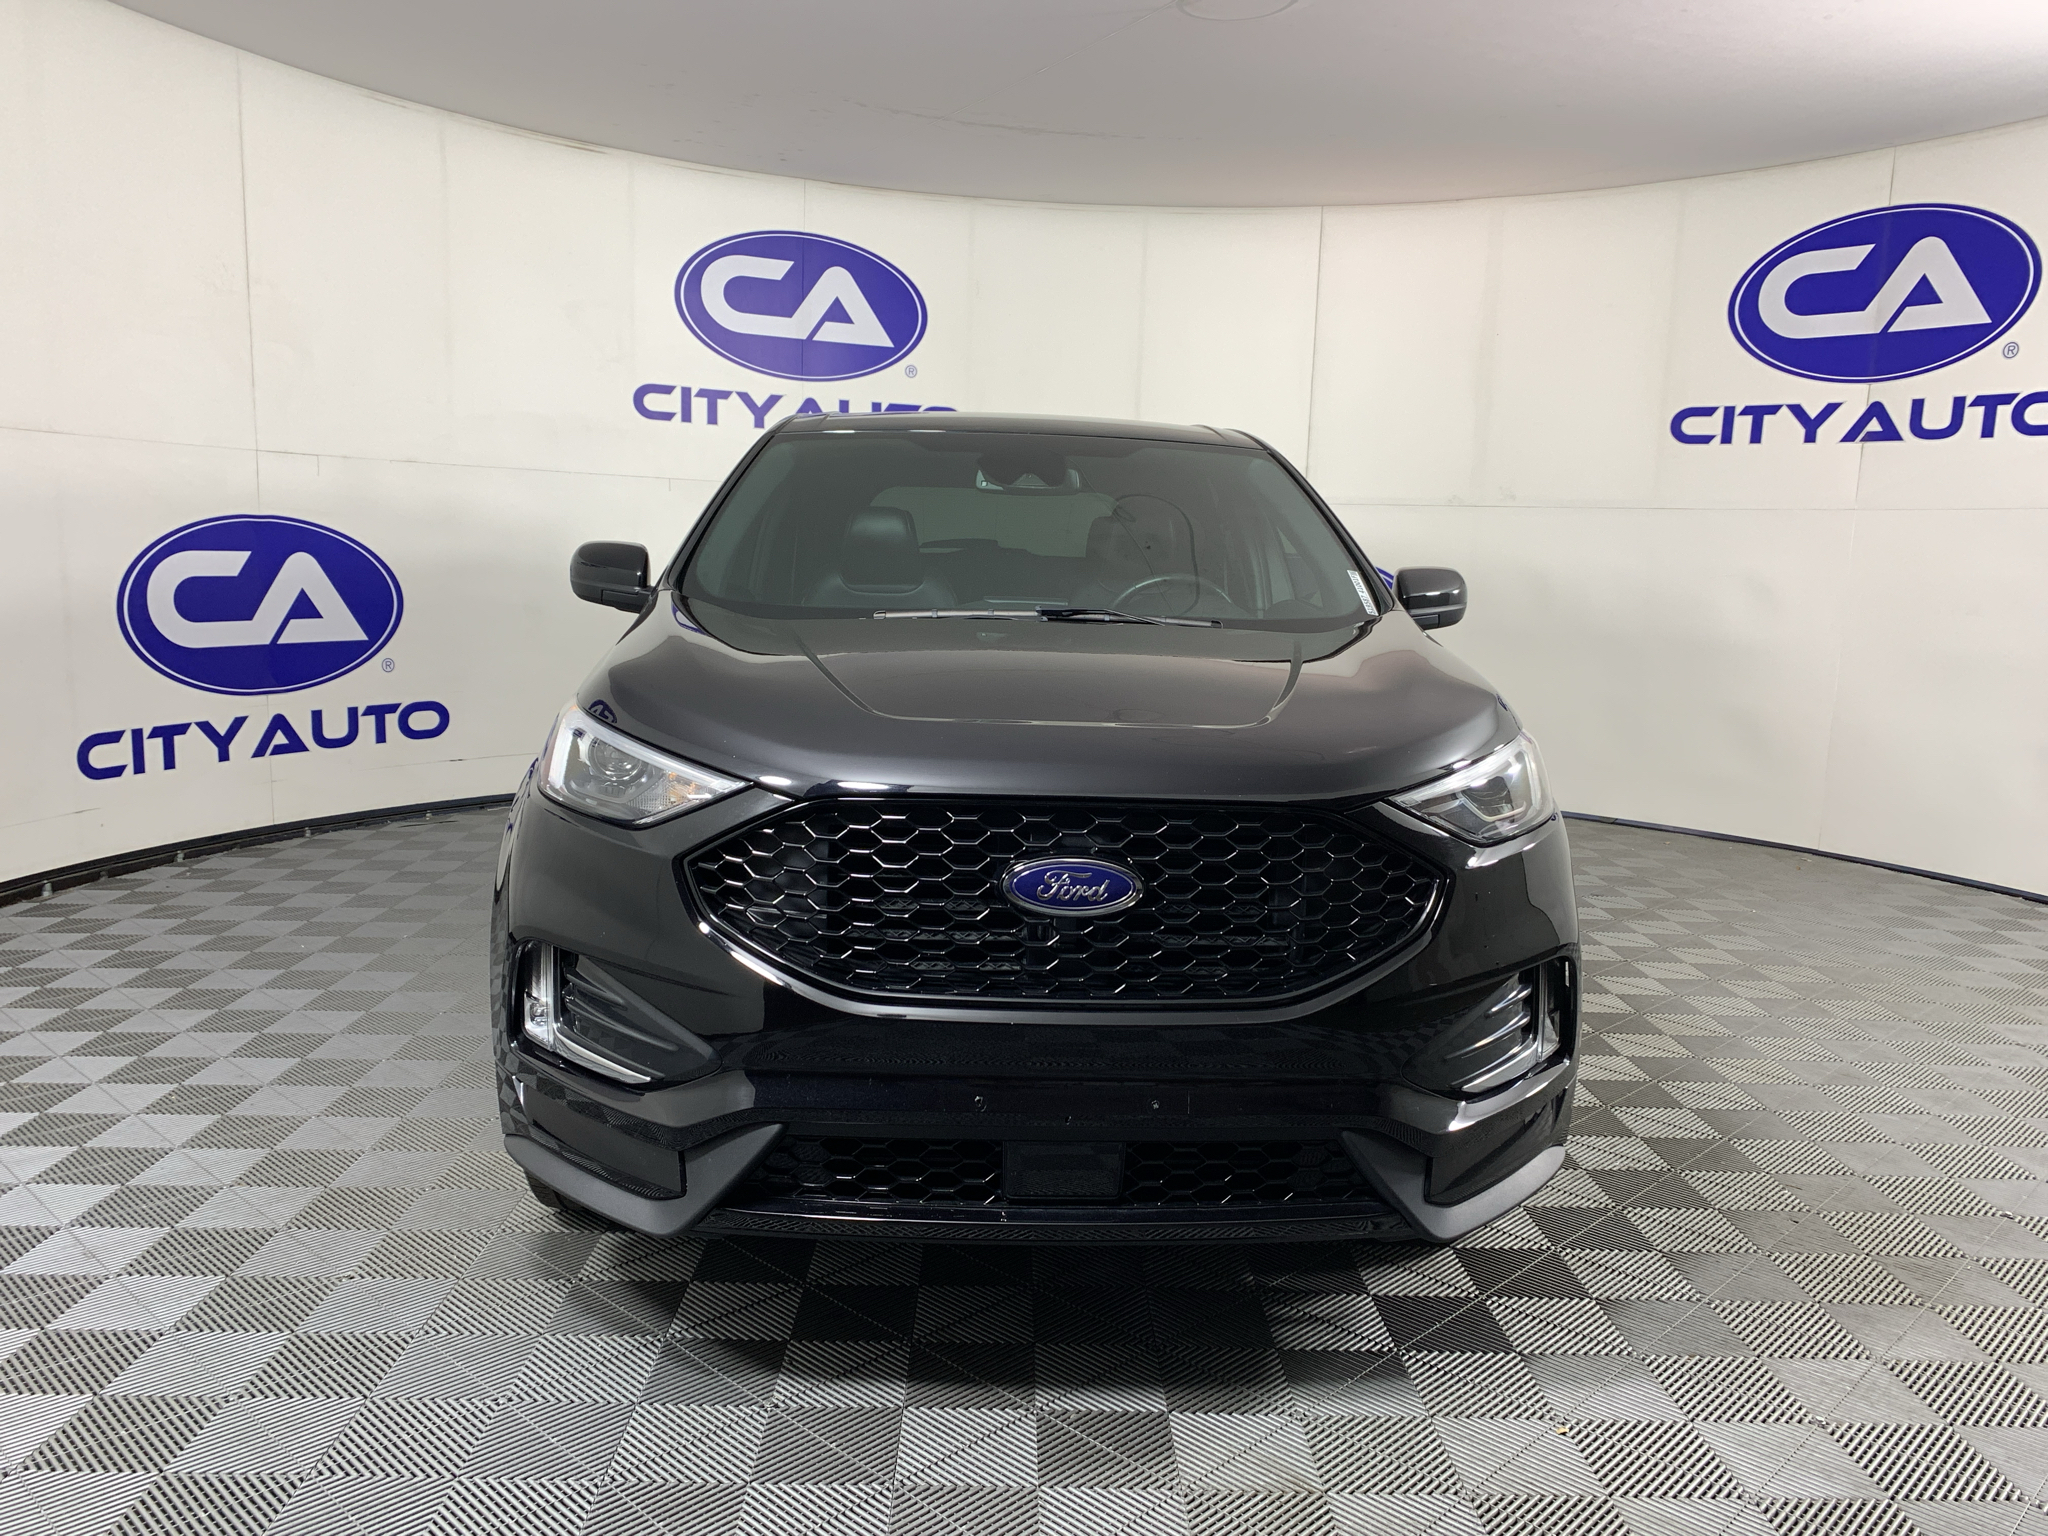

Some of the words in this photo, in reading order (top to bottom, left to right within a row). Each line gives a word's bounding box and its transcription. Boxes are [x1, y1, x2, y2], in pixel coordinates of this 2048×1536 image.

[701, 254, 895, 348] CA
[1758, 235, 1993, 339] CA
[633, 383, 785, 429] CITY
[1670, 403, 1846, 444] CITY
[146, 550, 369, 648] CA
[76, 715, 249, 780] CITY
[250, 700, 450, 759] AUTO
[1036, 869, 1111, 902] Ford
